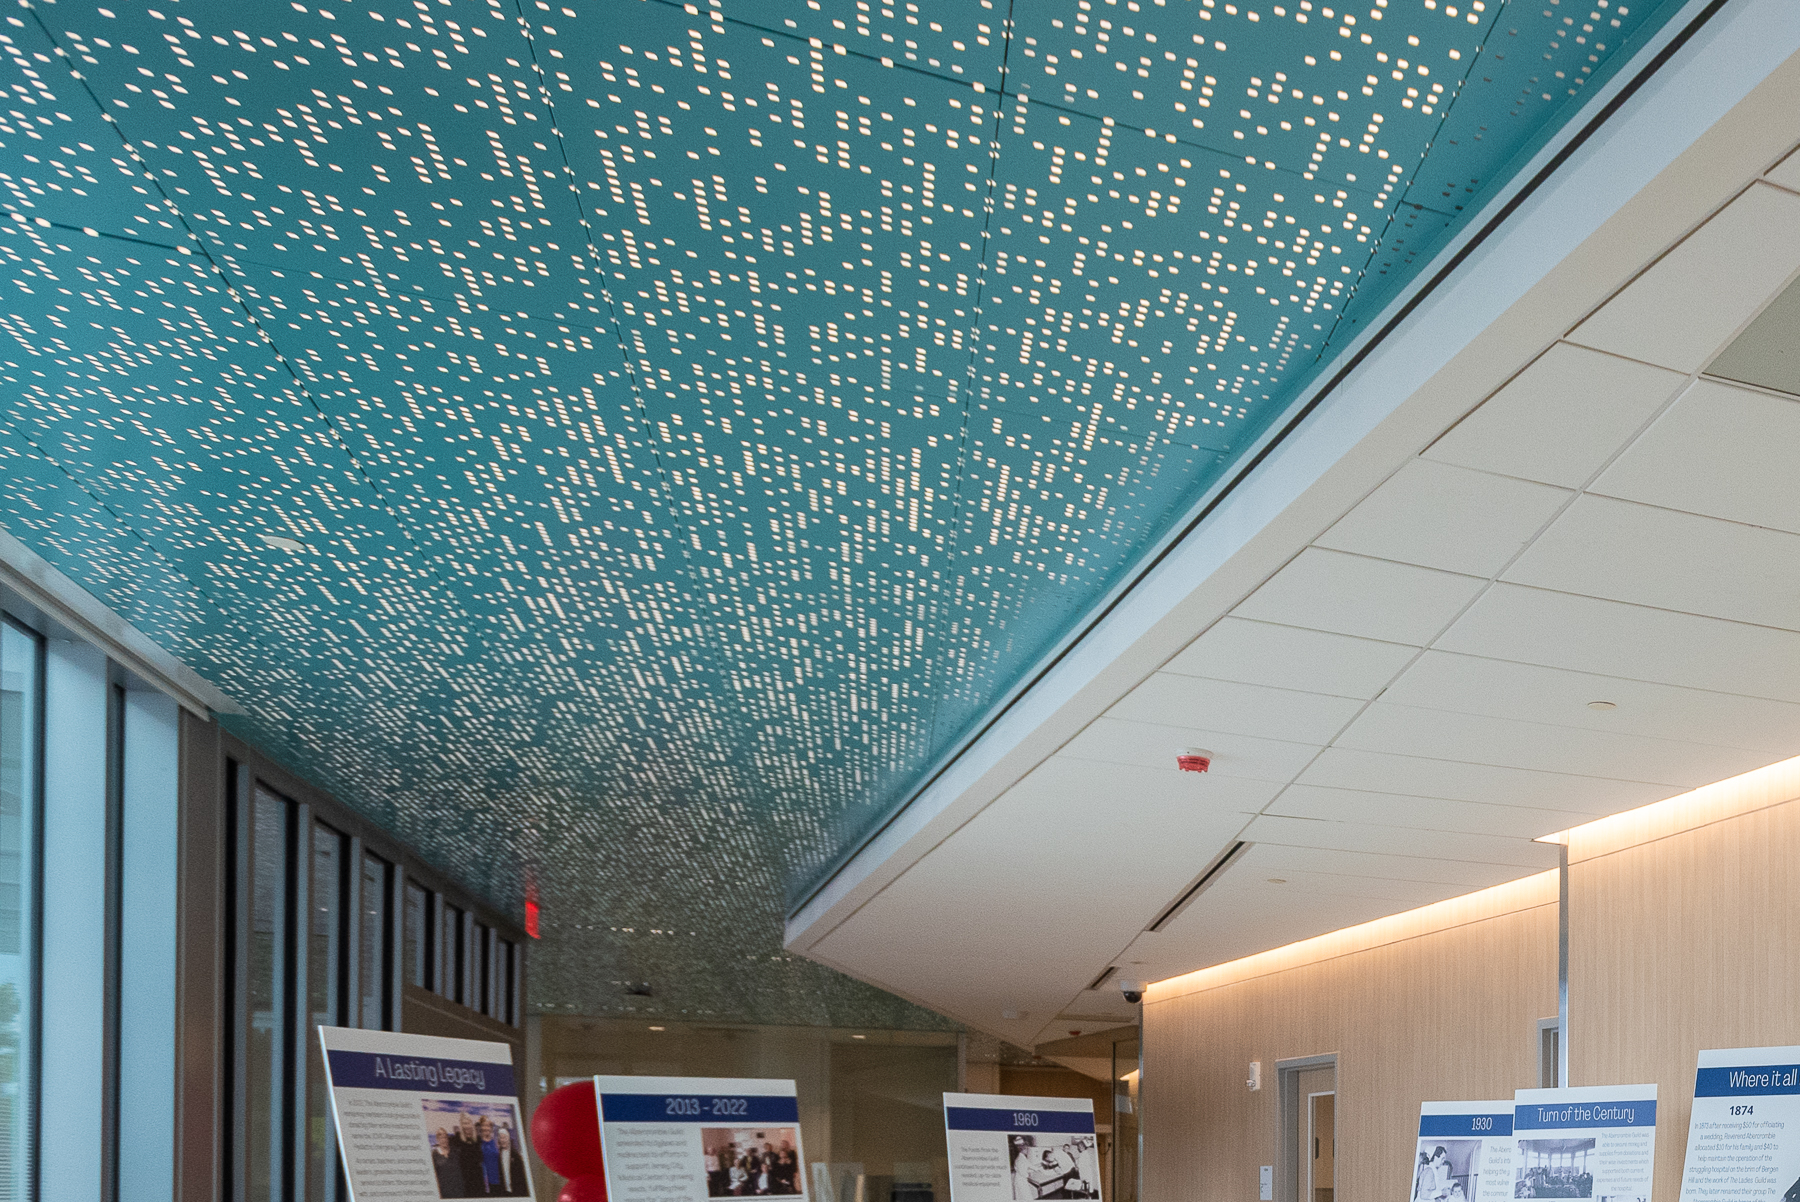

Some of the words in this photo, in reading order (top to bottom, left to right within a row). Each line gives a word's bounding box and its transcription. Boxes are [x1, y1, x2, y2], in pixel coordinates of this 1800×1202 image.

[376, 1057, 387, 1077] A
[387, 1058, 438, 1087] Lasting
[438, 1062, 485, 1089] Legacy
[1730, 1071, 1768, 1087] Where
[1771, 1070, 1781, 1086] it
[1783, 1070, 1798, 1086] all
[666, 1098, 700, 1115] 2013
[713, 1099, 747, 1115] 2022
[1538, 1108, 1558, 1122] Turn
[1561, 1106, 1573, 1121] of
[1574, 1106, 1591, 1121] the
[1593, 1106, 1634, 1123] Century
[1730, 1105, 1753, 1115] 1874
[1013, 1113, 1038, 1126] 1960
[1472, 1118, 1492, 1130] 1930
